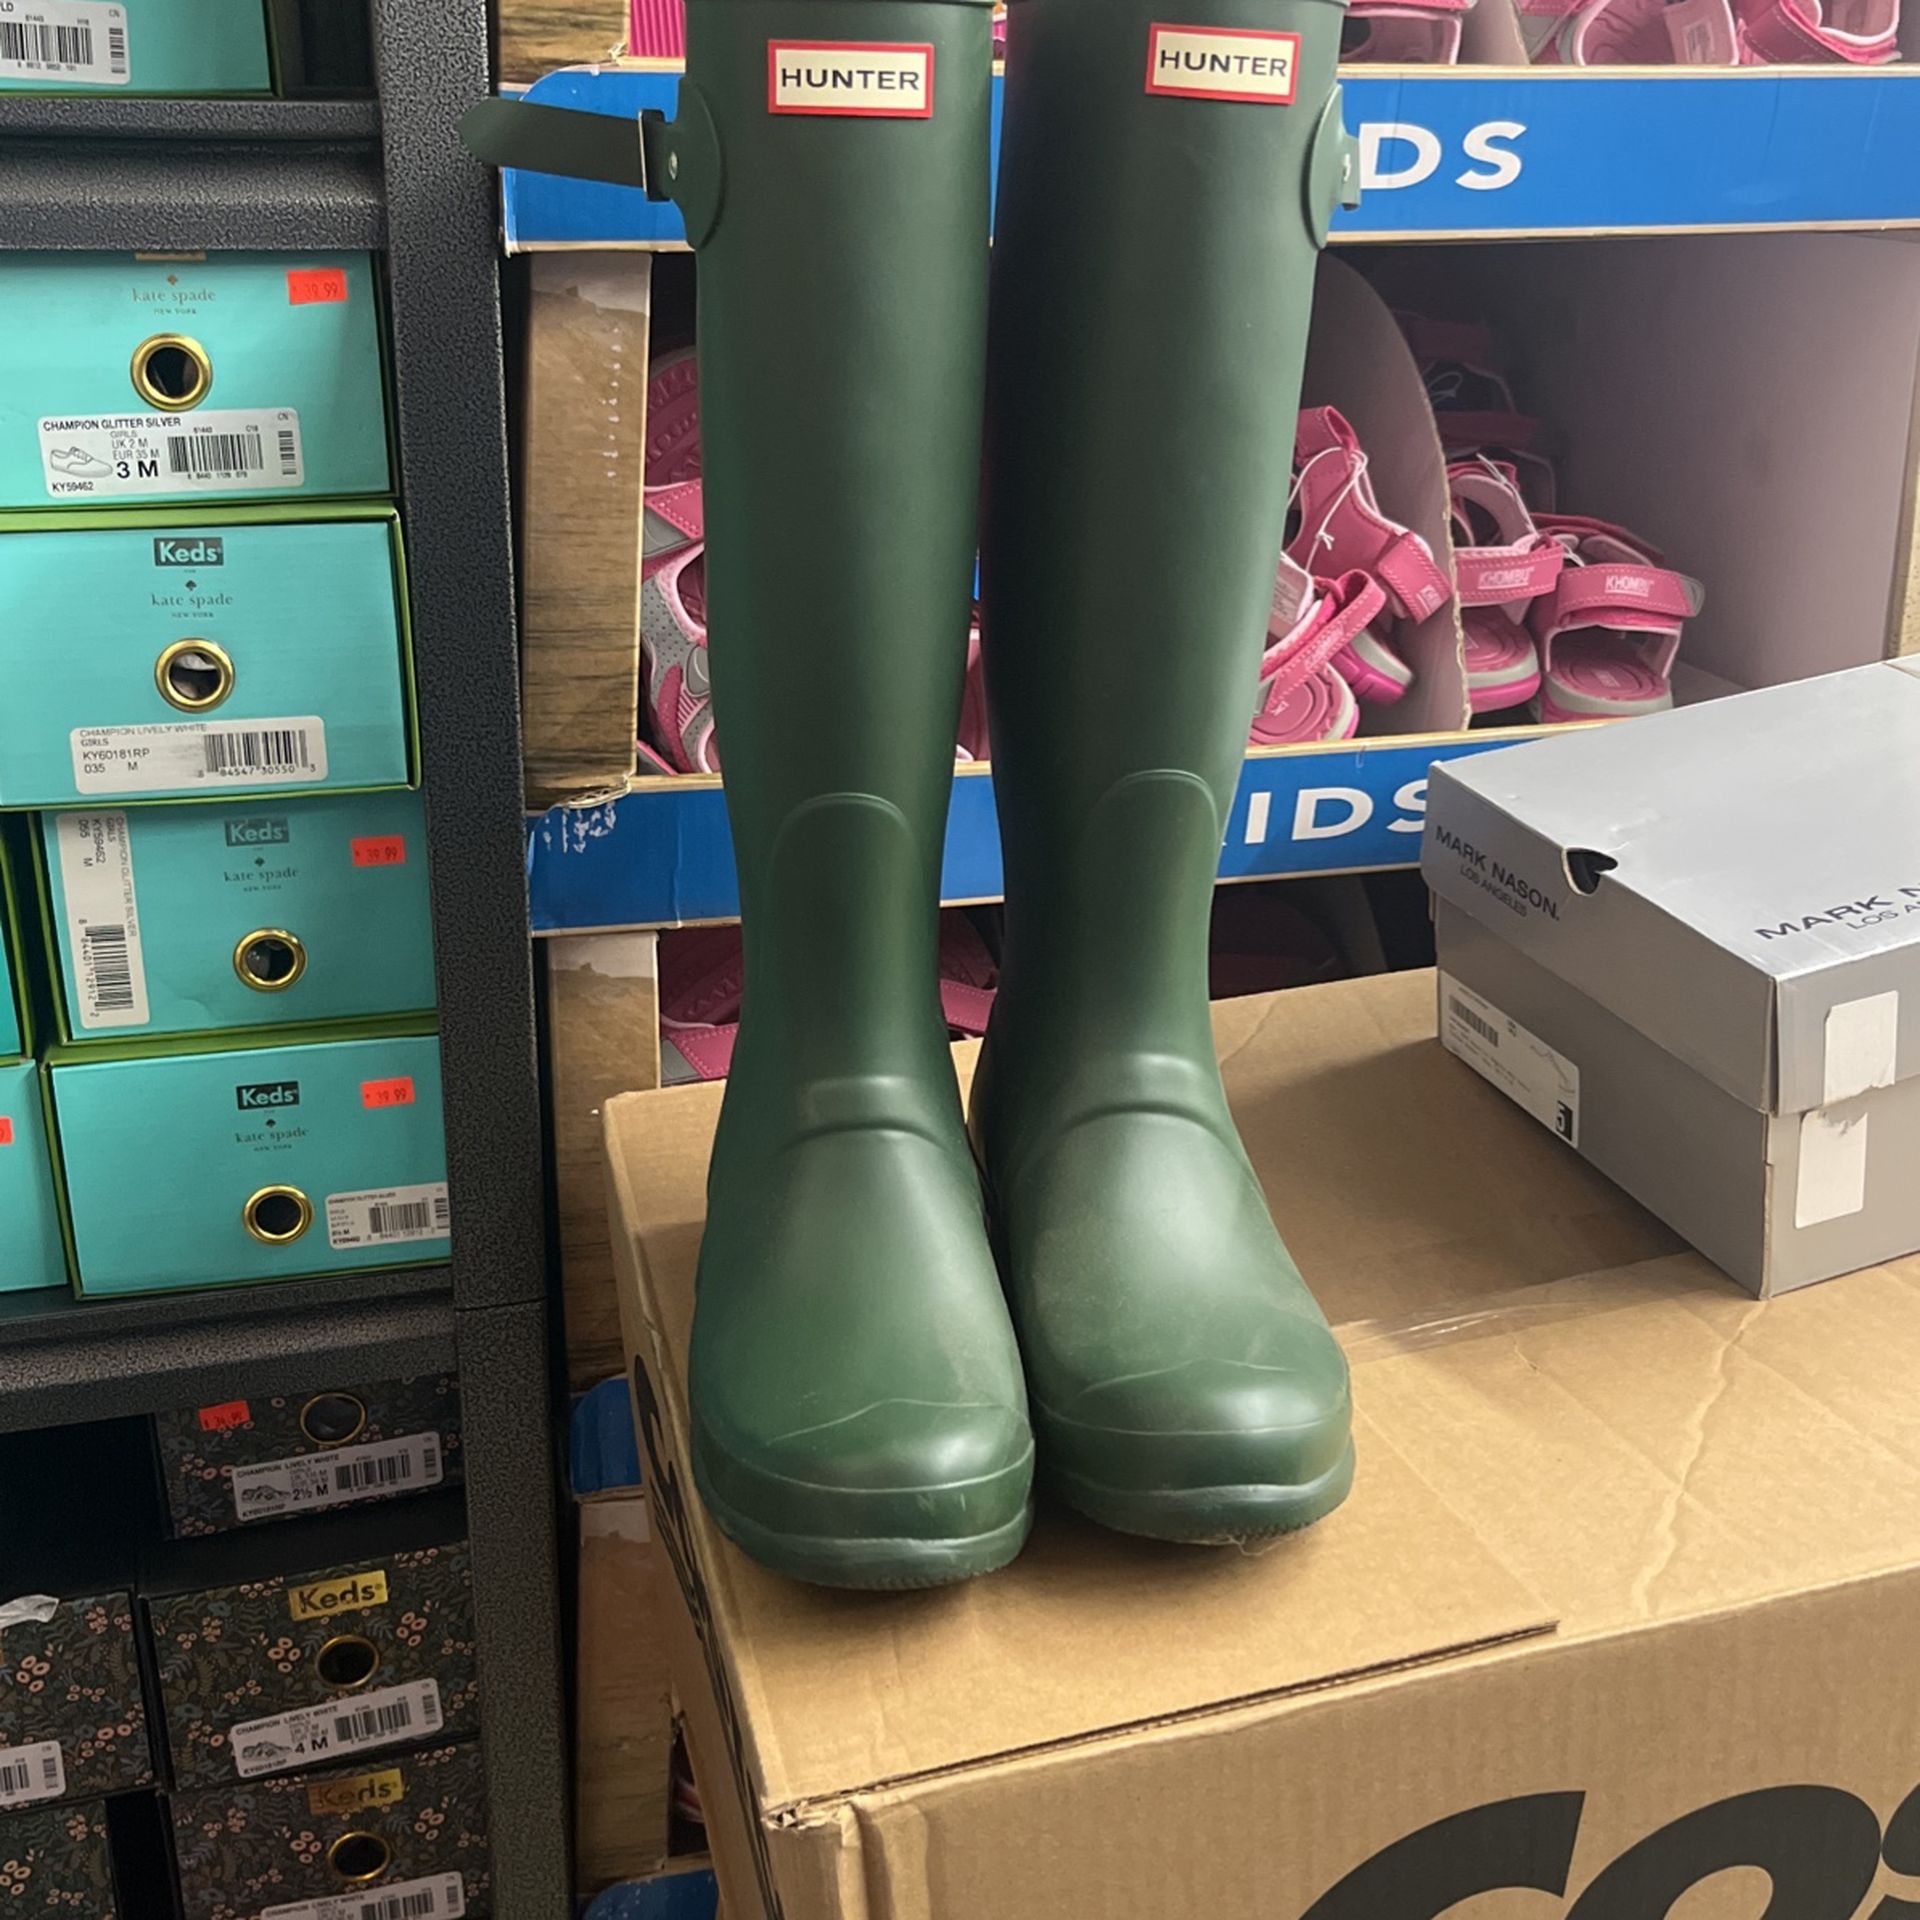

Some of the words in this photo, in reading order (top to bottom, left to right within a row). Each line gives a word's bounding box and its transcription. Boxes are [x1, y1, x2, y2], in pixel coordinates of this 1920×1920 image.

[0, 2, 14, 12] LD
[1160, 50, 1287, 77] HUNTER
[782, 68, 919, 90] HUNTER
[1359, 121, 1527, 190] DS
[132, 289, 166, 302] kate
[172, 288, 216, 304] spade
[43, 421, 99, 431] CHAMPION
[102, 419, 143, 429] GLITTER
[146, 417, 181, 428] SILVER
[112, 440, 126, 449] UK
[128, 439, 135, 448] 2
[138, 439, 148, 448] M
[112, 450, 133, 460] EUR
[151, 449, 160, 458] M
[117, 461, 130, 478] 3
[138, 460, 158, 477] M
[52, 481, 94, 492] KY59462
[160, 541, 218, 562] Keds
[151, 594, 184, 606] kate
[190, 593, 233, 608] spade
[80, 728, 135, 738] CHAMPION
[137, 725, 171, 735] LIVELY
[174, 724, 207, 733] WHITE
[81, 738, 109, 747] GIRLS
[83, 748, 150, 760] KY60181RP
[84, 763, 106, 774] 035
[128, 762, 138, 771] M
[1222, 779, 1427, 846] IDS
[92, 819, 106, 863] KY59462
[117, 816, 129, 866] CHAMPION
[231, 822, 283, 843] Keds
[1436, 825, 1487, 871] MARK
[83, 857, 93, 867] M
[224, 871, 254, 882] kate
[259, 867, 299, 883] spade
[121, 867, 133, 904] GLITTER
[1460, 864, 1480, 884] LOS
[1480, 879, 1527, 917] ANGELES
[125, 906, 137, 937] SILVER
[1755, 895, 1894, 939] MARK
[1846, 910, 1898, 929] LOS
[242, 1086, 294, 1106] Keds
[235, 1132, 264, 1143] kate
[270, 1127, 309, 1143] spade
[316, 1484, 329, 1496] M
[299, 1581, 375, 1613] Keds
[295, 1743, 305, 1753] 4
[311, 1736, 328, 1751] M
[316, 1779, 391, 1808] Keds
